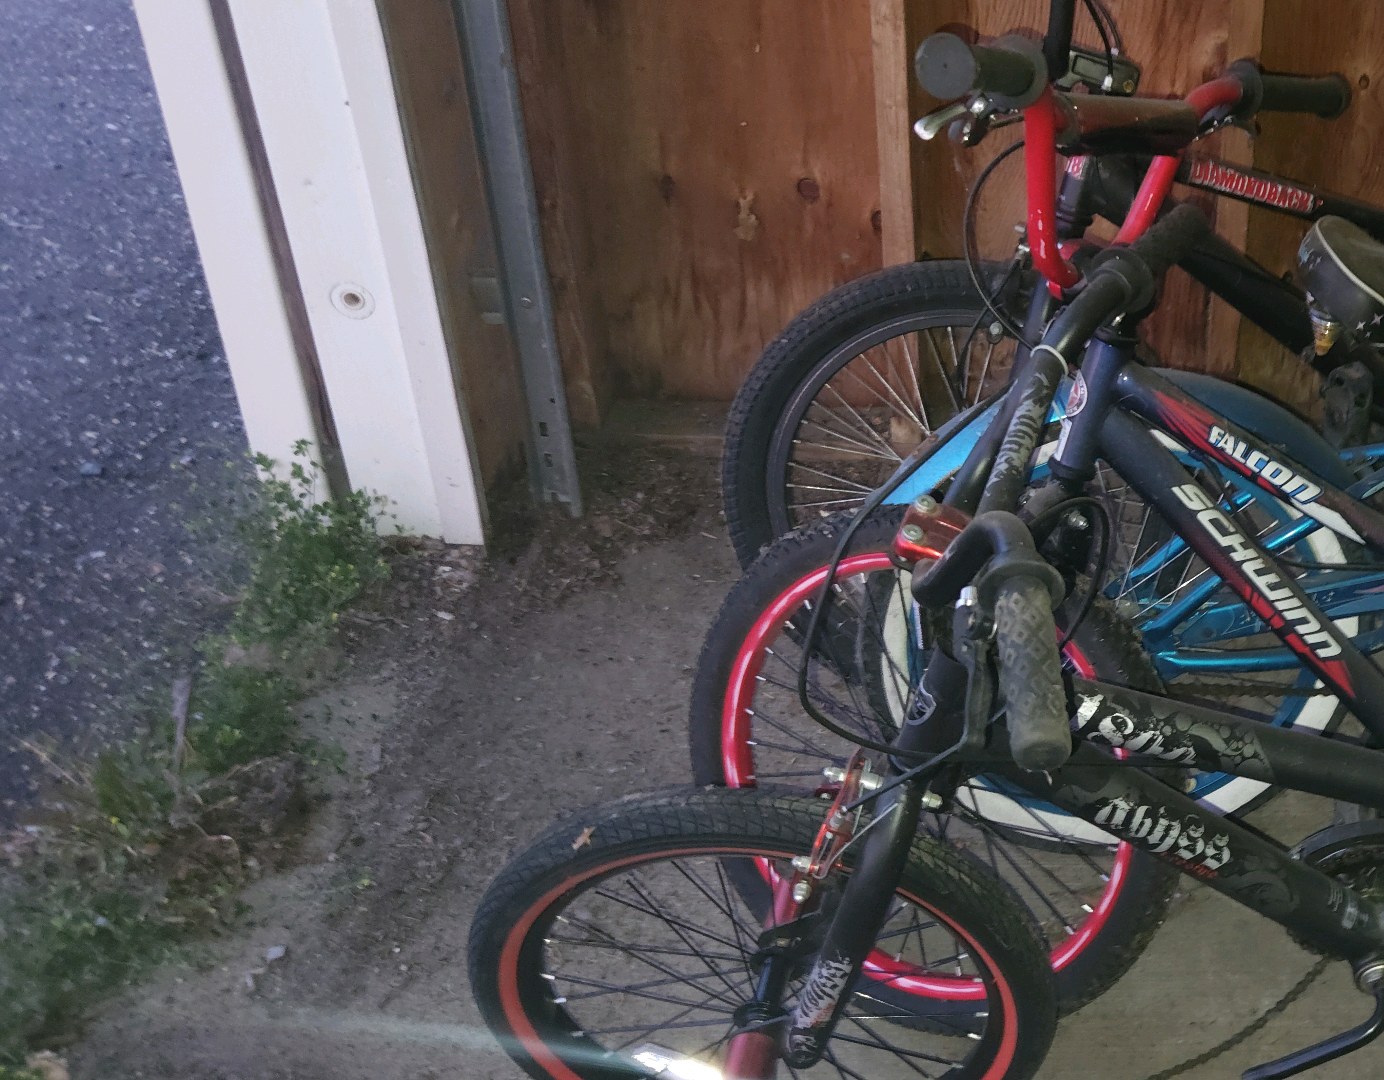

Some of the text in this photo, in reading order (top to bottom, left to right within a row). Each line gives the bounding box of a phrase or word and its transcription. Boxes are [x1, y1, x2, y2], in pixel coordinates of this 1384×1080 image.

[1191, 159, 1315, 213] DIAMONDBACK
[1208, 425, 1323, 503] FALCON
[1171, 483, 1342, 659] SCHWINN
